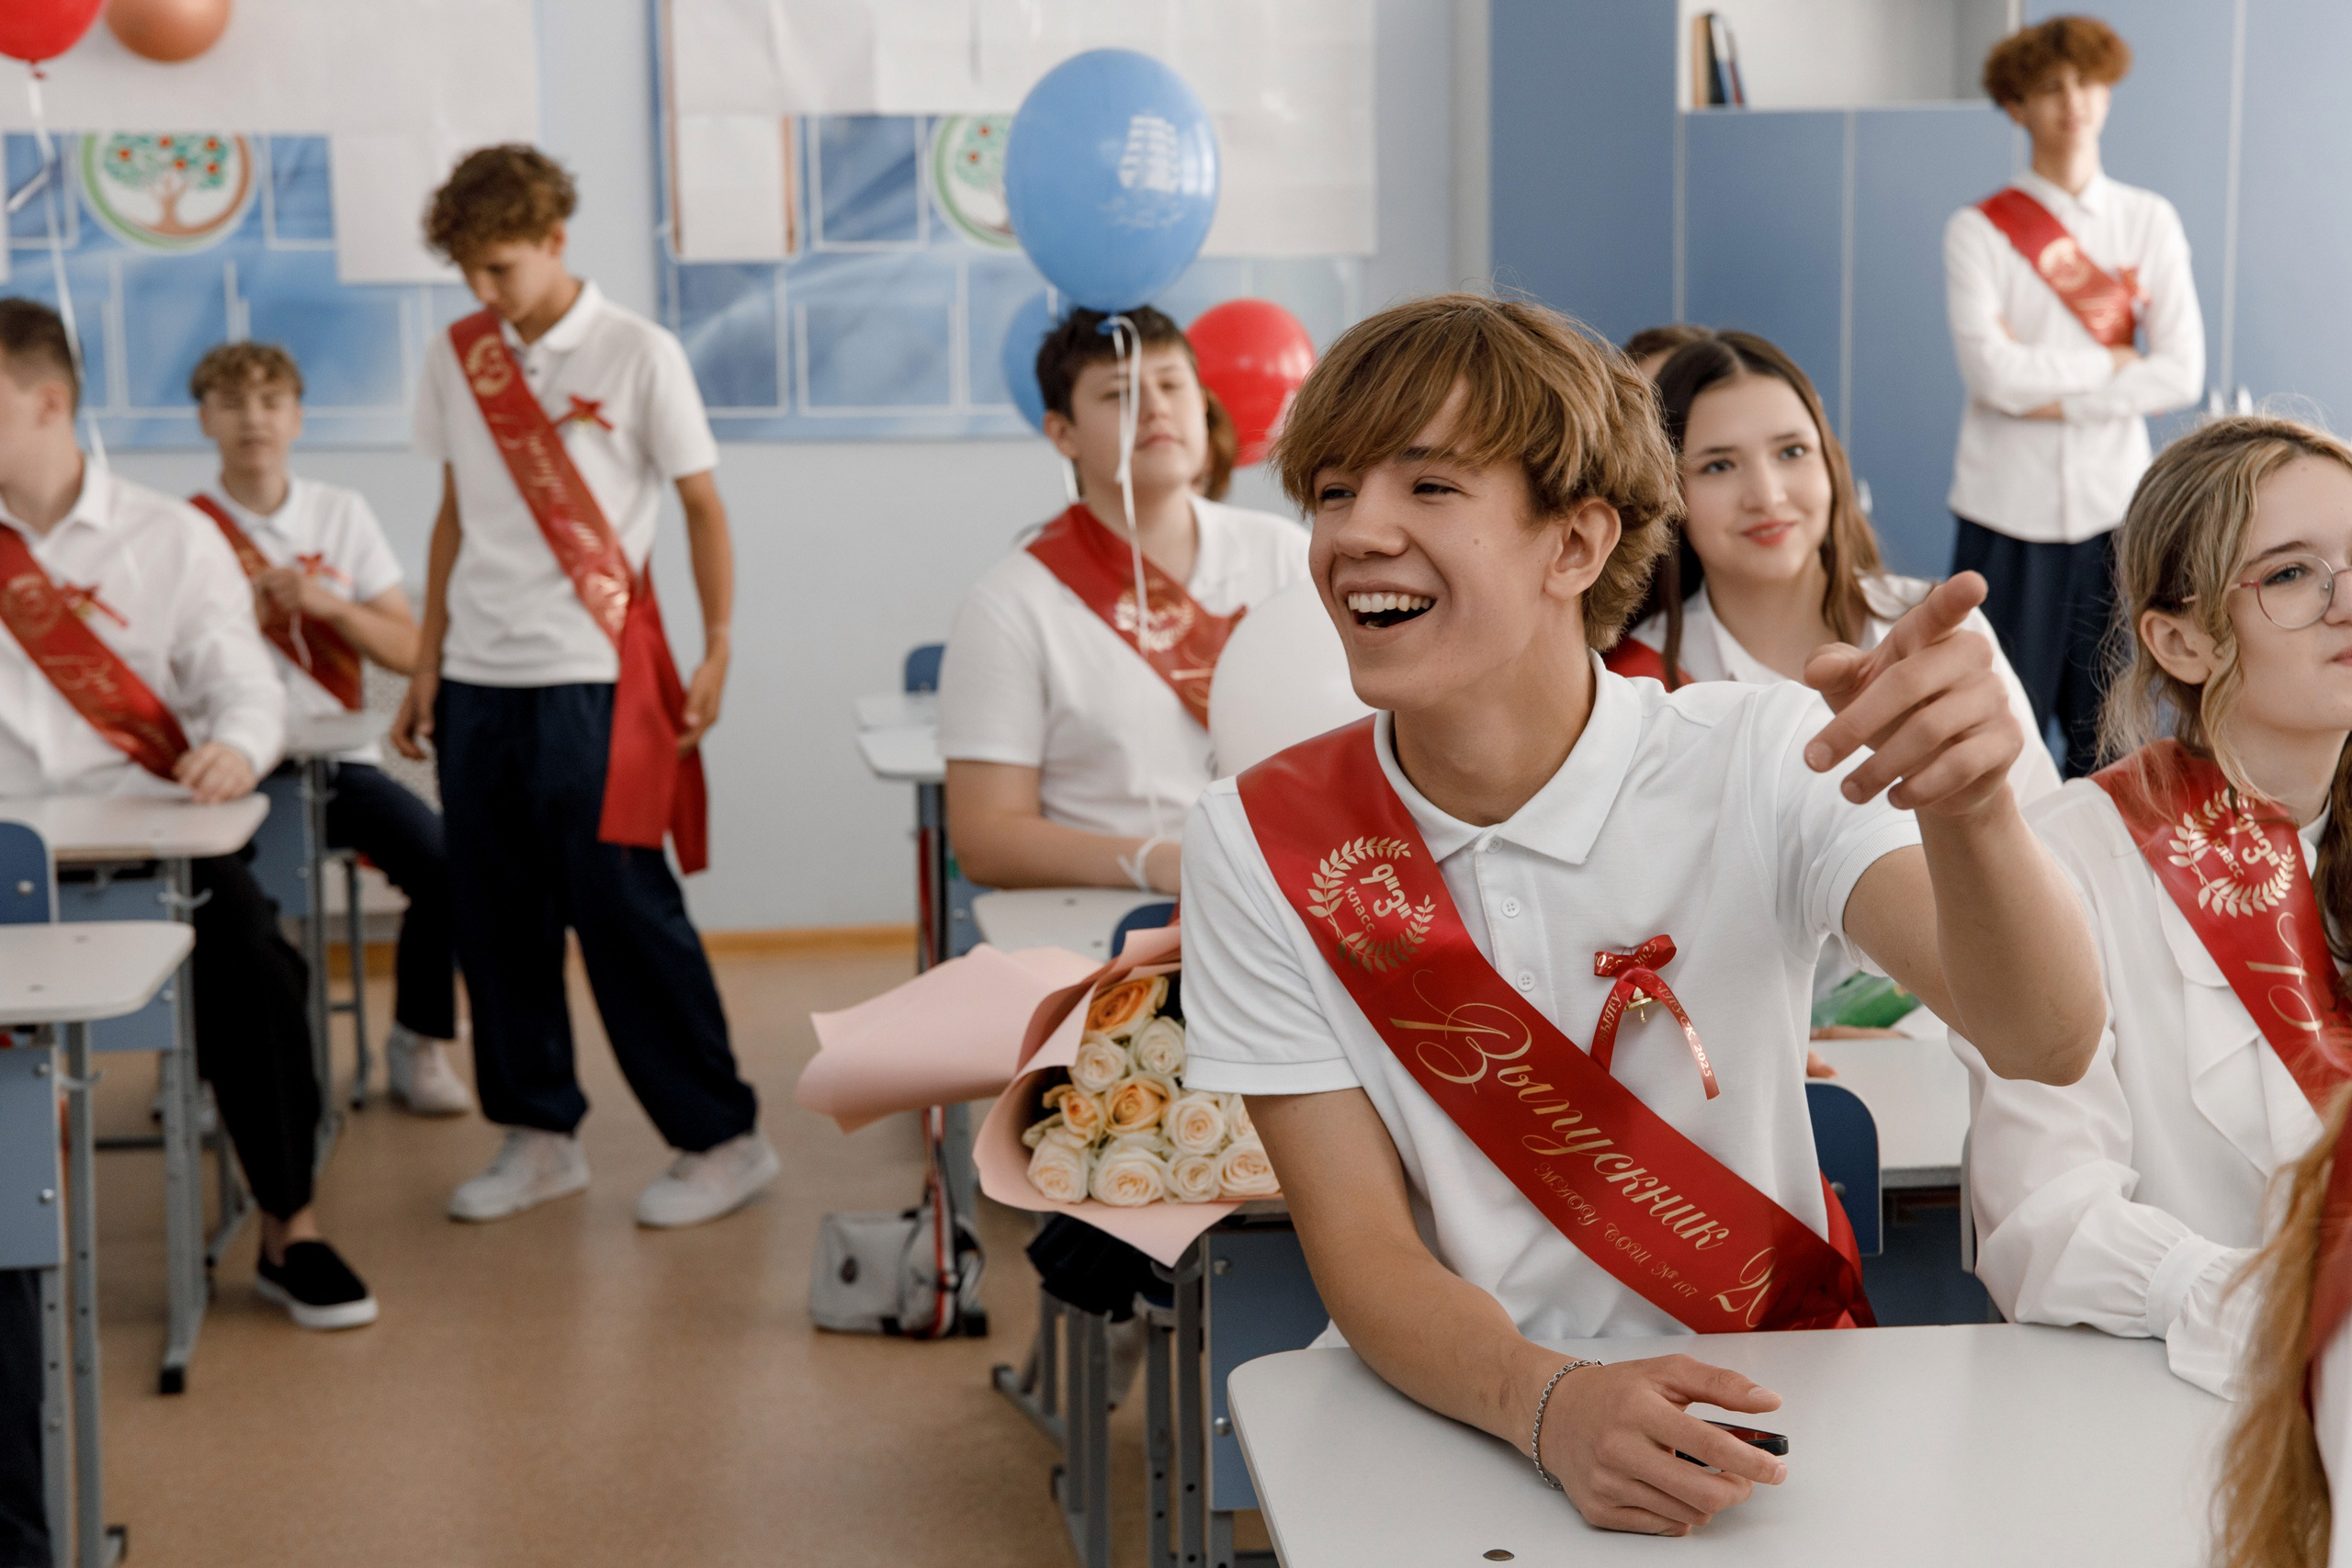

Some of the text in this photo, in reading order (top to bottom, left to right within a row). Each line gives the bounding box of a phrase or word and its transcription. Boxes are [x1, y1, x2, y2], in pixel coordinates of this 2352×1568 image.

[1345, 886, 1375, 933] класс
[1595, 953, 1623, 970] 025
[1693, 1044, 1713, 1077] 2025
[1388, 968, 1730, 1251] Выпускник
[1533, 1163, 1600, 1226] МАОУ
[1604, 1223, 1652, 1266] СОШ
